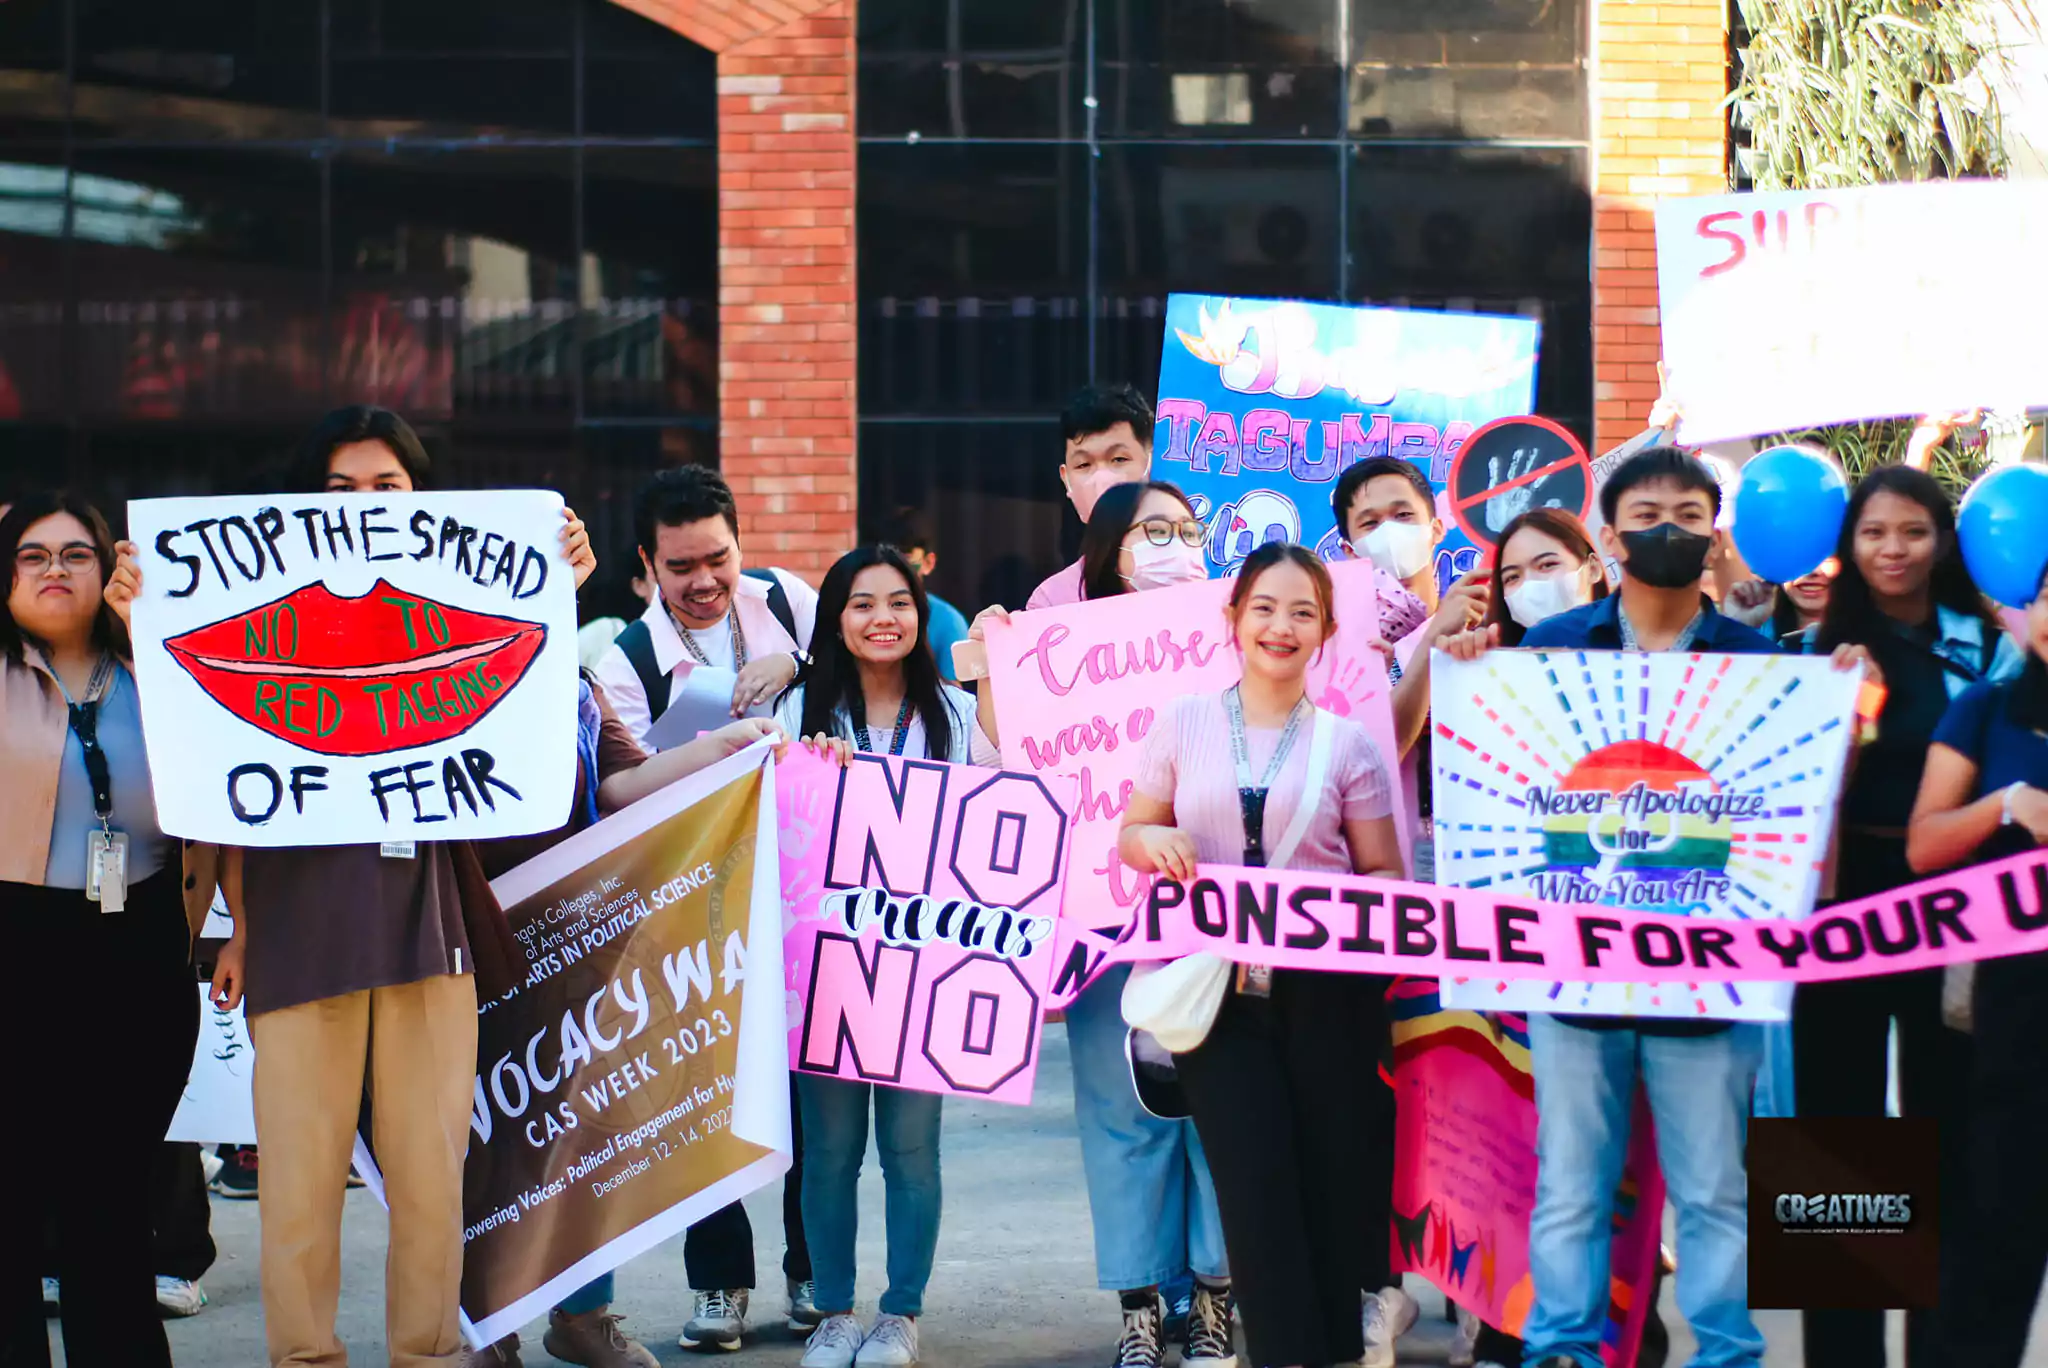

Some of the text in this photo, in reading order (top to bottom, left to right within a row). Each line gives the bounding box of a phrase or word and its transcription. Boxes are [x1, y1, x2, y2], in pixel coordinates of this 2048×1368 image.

[155, 506, 549, 600] STOP THE SPREAD
[246, 596, 451, 661] NO TO
[1017, 623, 1220, 697] Cause
[254, 661, 504, 738] RED TAGGING
[1021, 715, 1118, 770] was
[227, 748, 524, 826] OF FEAR
[1525, 781, 1766, 825] Never Apologize
[824, 753, 1068, 911] NO
[1618, 827, 1651, 850] for
[525, 888, 640, 960] of Arts and Sciences
[545, 888, 602, 925] Colleges,
[600, 875, 625, 893] Inc.
[823, 888, 1053, 958] means
[1146, 877, 1546, 967] PONSIBLE
[1575, 916, 1742, 970] FOR
[1755, 888, 1976, 969] YOUR
[1529, 868, 1732, 906] Who You Are
[525, 953, 563, 990] ARTS
[560, 941, 584, 967] IN
[581, 899, 653, 954] POLITICAL
[651, 861, 717, 910] SCIENCE
[798, 930, 1040, 1095] NO
[525, 1009, 733, 1149] CAS WEEK 2023
[518, 1176, 567, 1213] Voices:
[566, 1139, 616, 1184] Political
[615, 1101, 695, 1151] Engagement
[693, 1085, 715, 1107] for
[592, 1156, 652, 1199] December
[651, 1143, 672, 1162] 12
[679, 1128, 704, 1148] 14,
